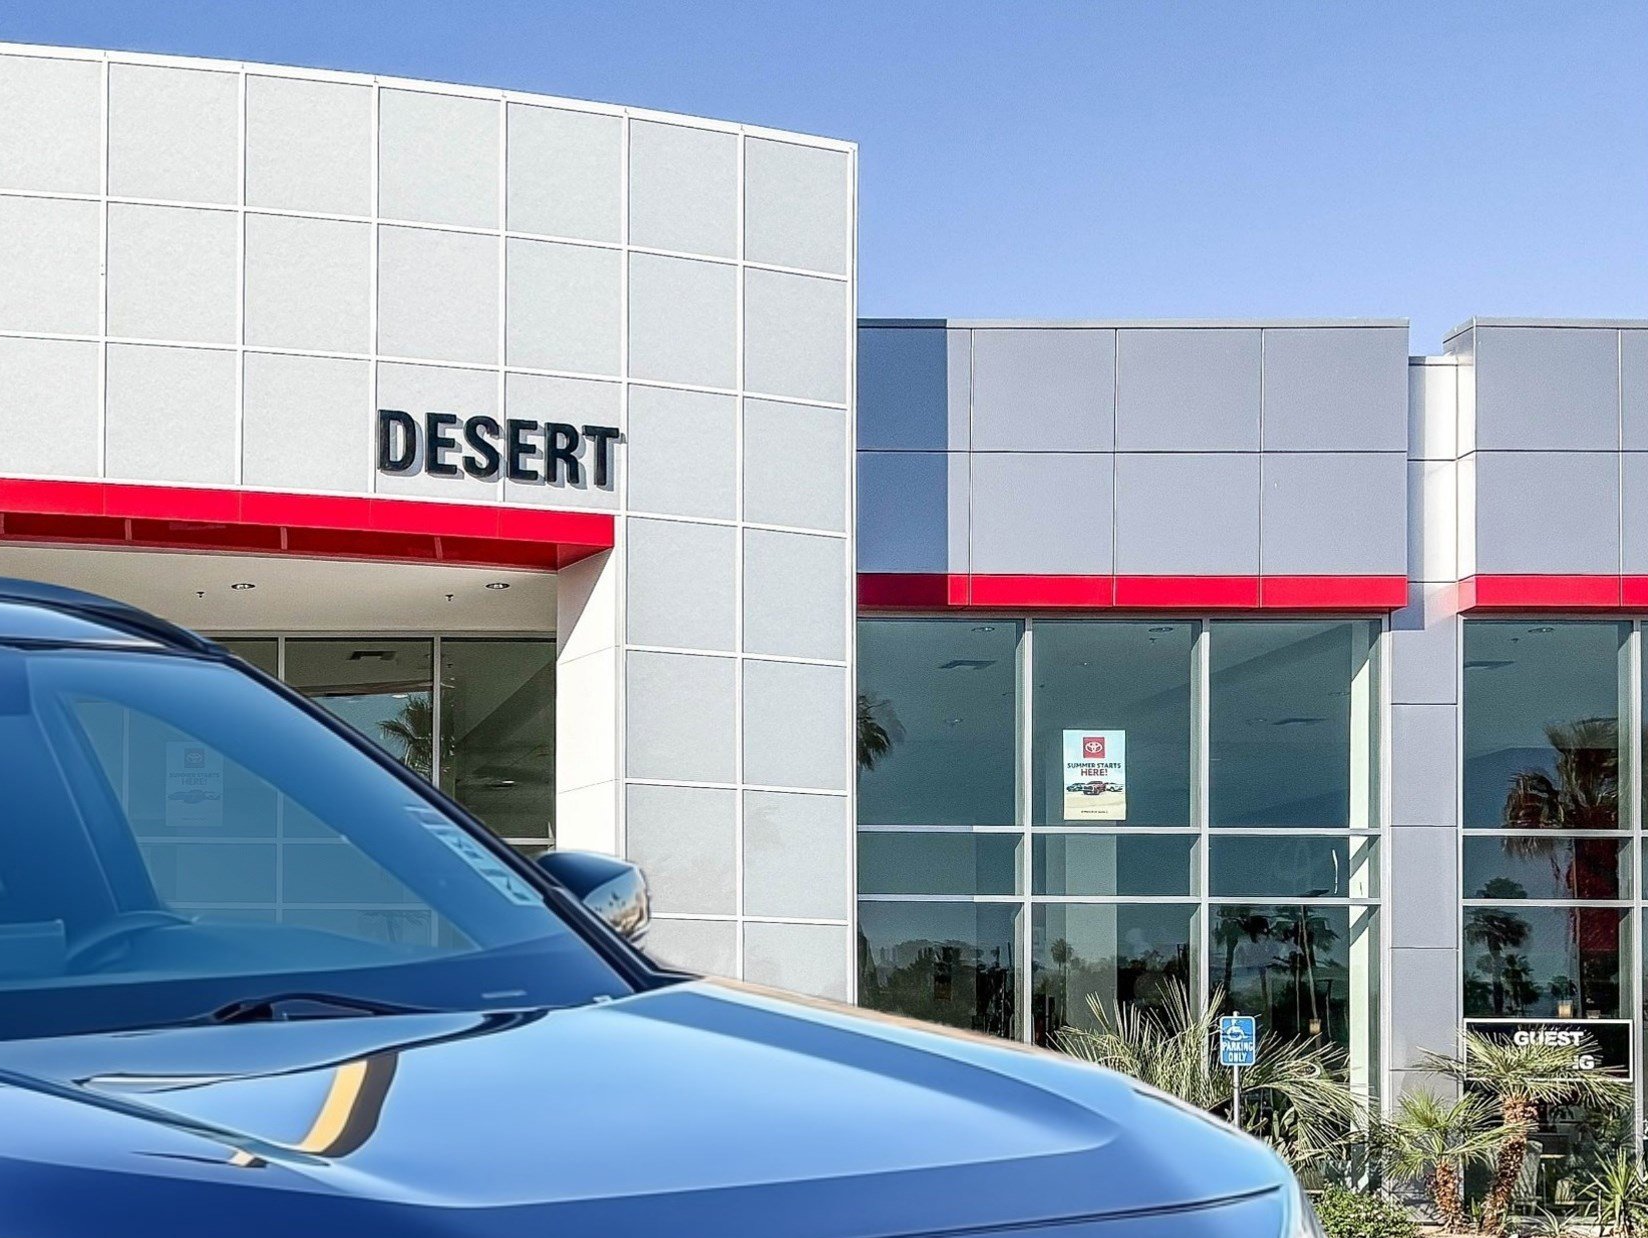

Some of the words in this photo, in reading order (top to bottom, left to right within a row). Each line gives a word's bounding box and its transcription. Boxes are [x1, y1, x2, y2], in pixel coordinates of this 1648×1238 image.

[377, 409, 619, 486] DESERT
[1081, 768, 1108, 776] HERE!
[1513, 1030, 1584, 1047] GUEST
[1222, 1041, 1254, 1052] PARKING
[1228, 1052, 1248, 1063] ONLY
